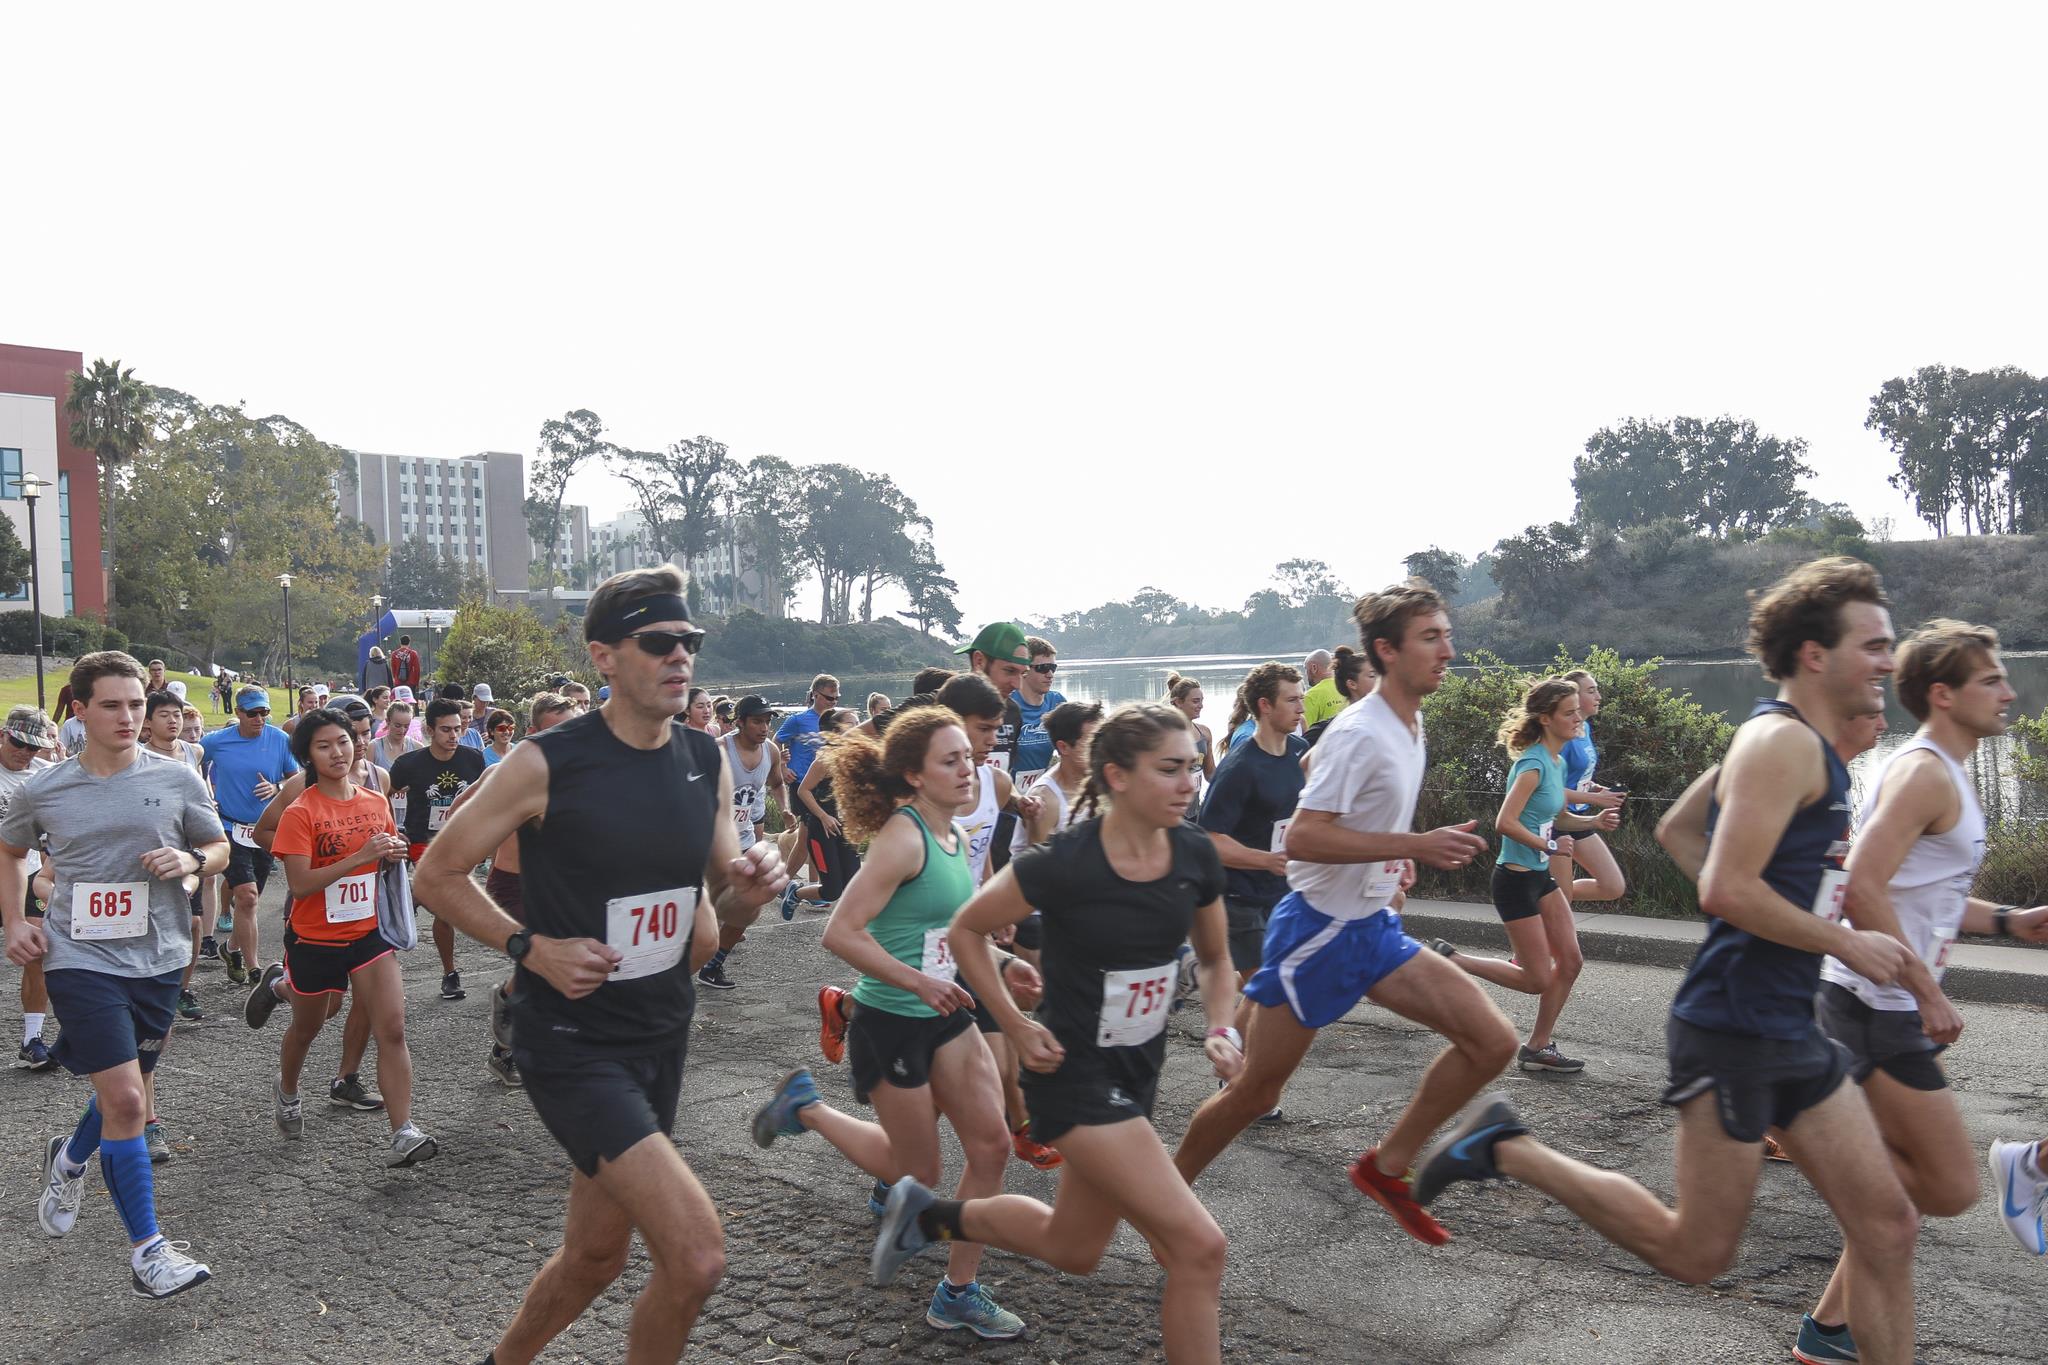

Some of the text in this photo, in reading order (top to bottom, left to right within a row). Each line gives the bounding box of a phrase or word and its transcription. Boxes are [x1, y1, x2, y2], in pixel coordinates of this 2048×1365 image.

[240, 826, 255, 839] 76
[89, 890, 132, 918] 685
[338, 880, 369, 904] 701
[630, 901, 677, 946] 740
[1125, 976, 1169, 1018] 755
